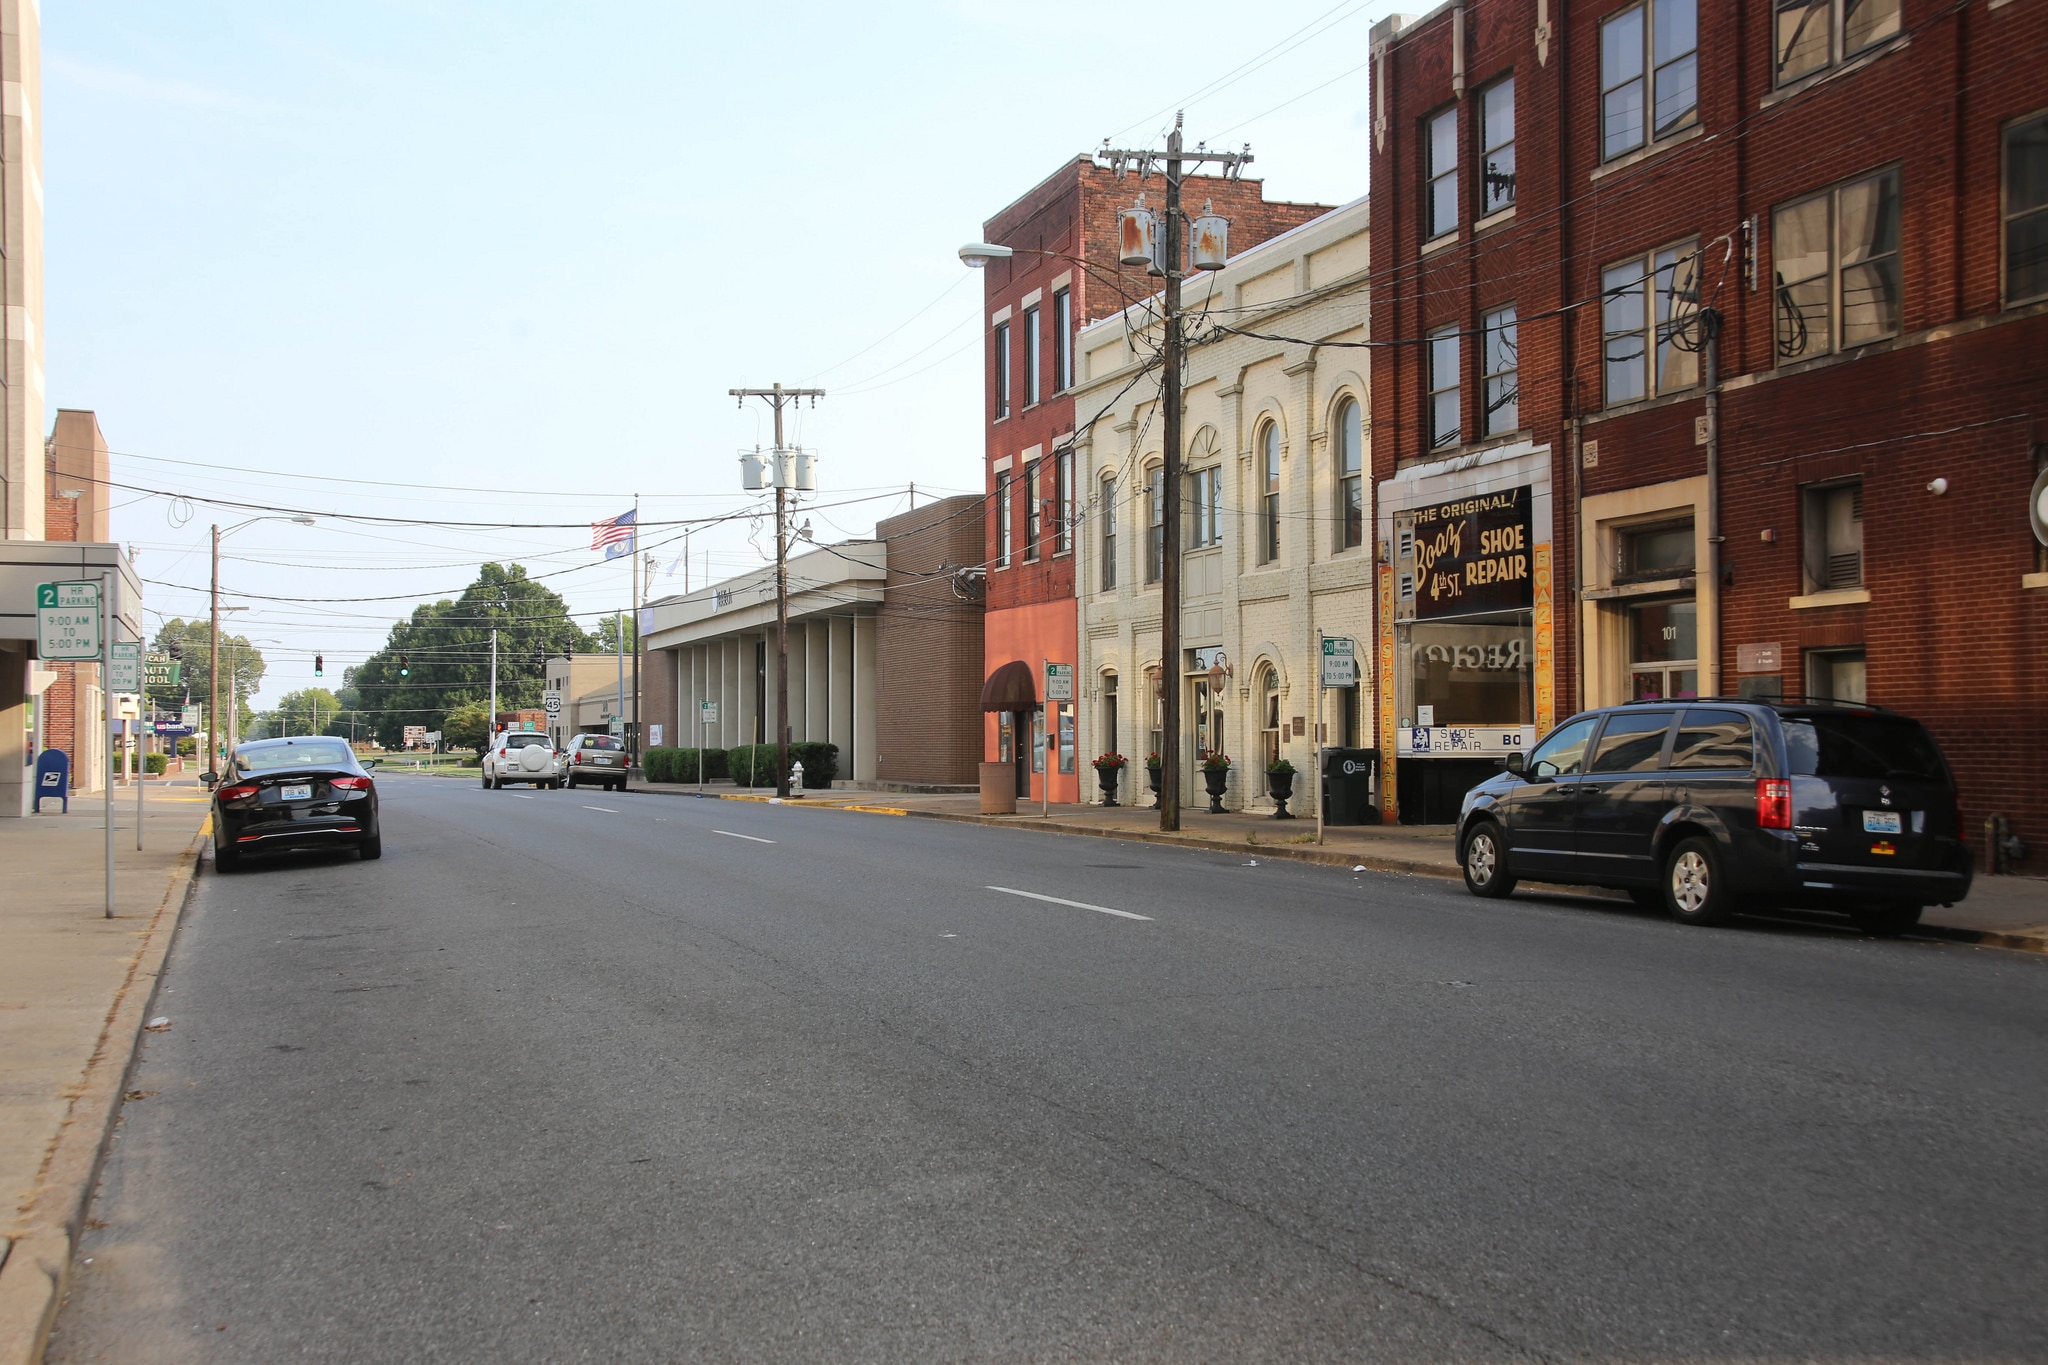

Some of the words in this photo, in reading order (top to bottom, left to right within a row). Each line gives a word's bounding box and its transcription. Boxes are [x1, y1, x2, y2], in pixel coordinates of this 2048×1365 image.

[1414, 508, 1437, 524] THE
[1441, 489, 1517, 519] ORIGINAL!
[1480, 524, 1525, 555] SHOE
[1414, 519, 1467, 593] Boaz
[1466, 554, 1528, 586] REPAIR
[70, 586, 84, 596] HR
[1430, 571, 1447, 601] 4th
[1447, 573, 1462, 598] ST.
[1535, 550, 1552, 625] BOAZ
[43, 589, 55, 606] 2
[60, 596, 96, 606] PARKING
[1381, 571, 1393, 637] BOAZ
[48, 616, 72, 626] 9:00
[75, 616, 90, 625] AM
[63, 627, 76, 637] TO
[1661, 626, 1677, 640] 101
[49, 639, 72, 649] 5:00
[76, 638, 90, 648] PM
[1324, 642, 1334, 653] 20
[1329, 660, 1341, 668] 9:00
[1536, 629, 1553, 706] SHOE
[1050, 667, 1056, 675] 2
[1326, 672, 1333, 680] TO
[1333, 672, 1345, 680] 5:00
[1346, 672, 1352, 680] PM
[547, 701, 559, 709] 45
[1440, 728, 1475, 739] SHOE
[1434, 741, 1482, 751] REPAIR
[1382, 714, 1395, 812] REPAIR
